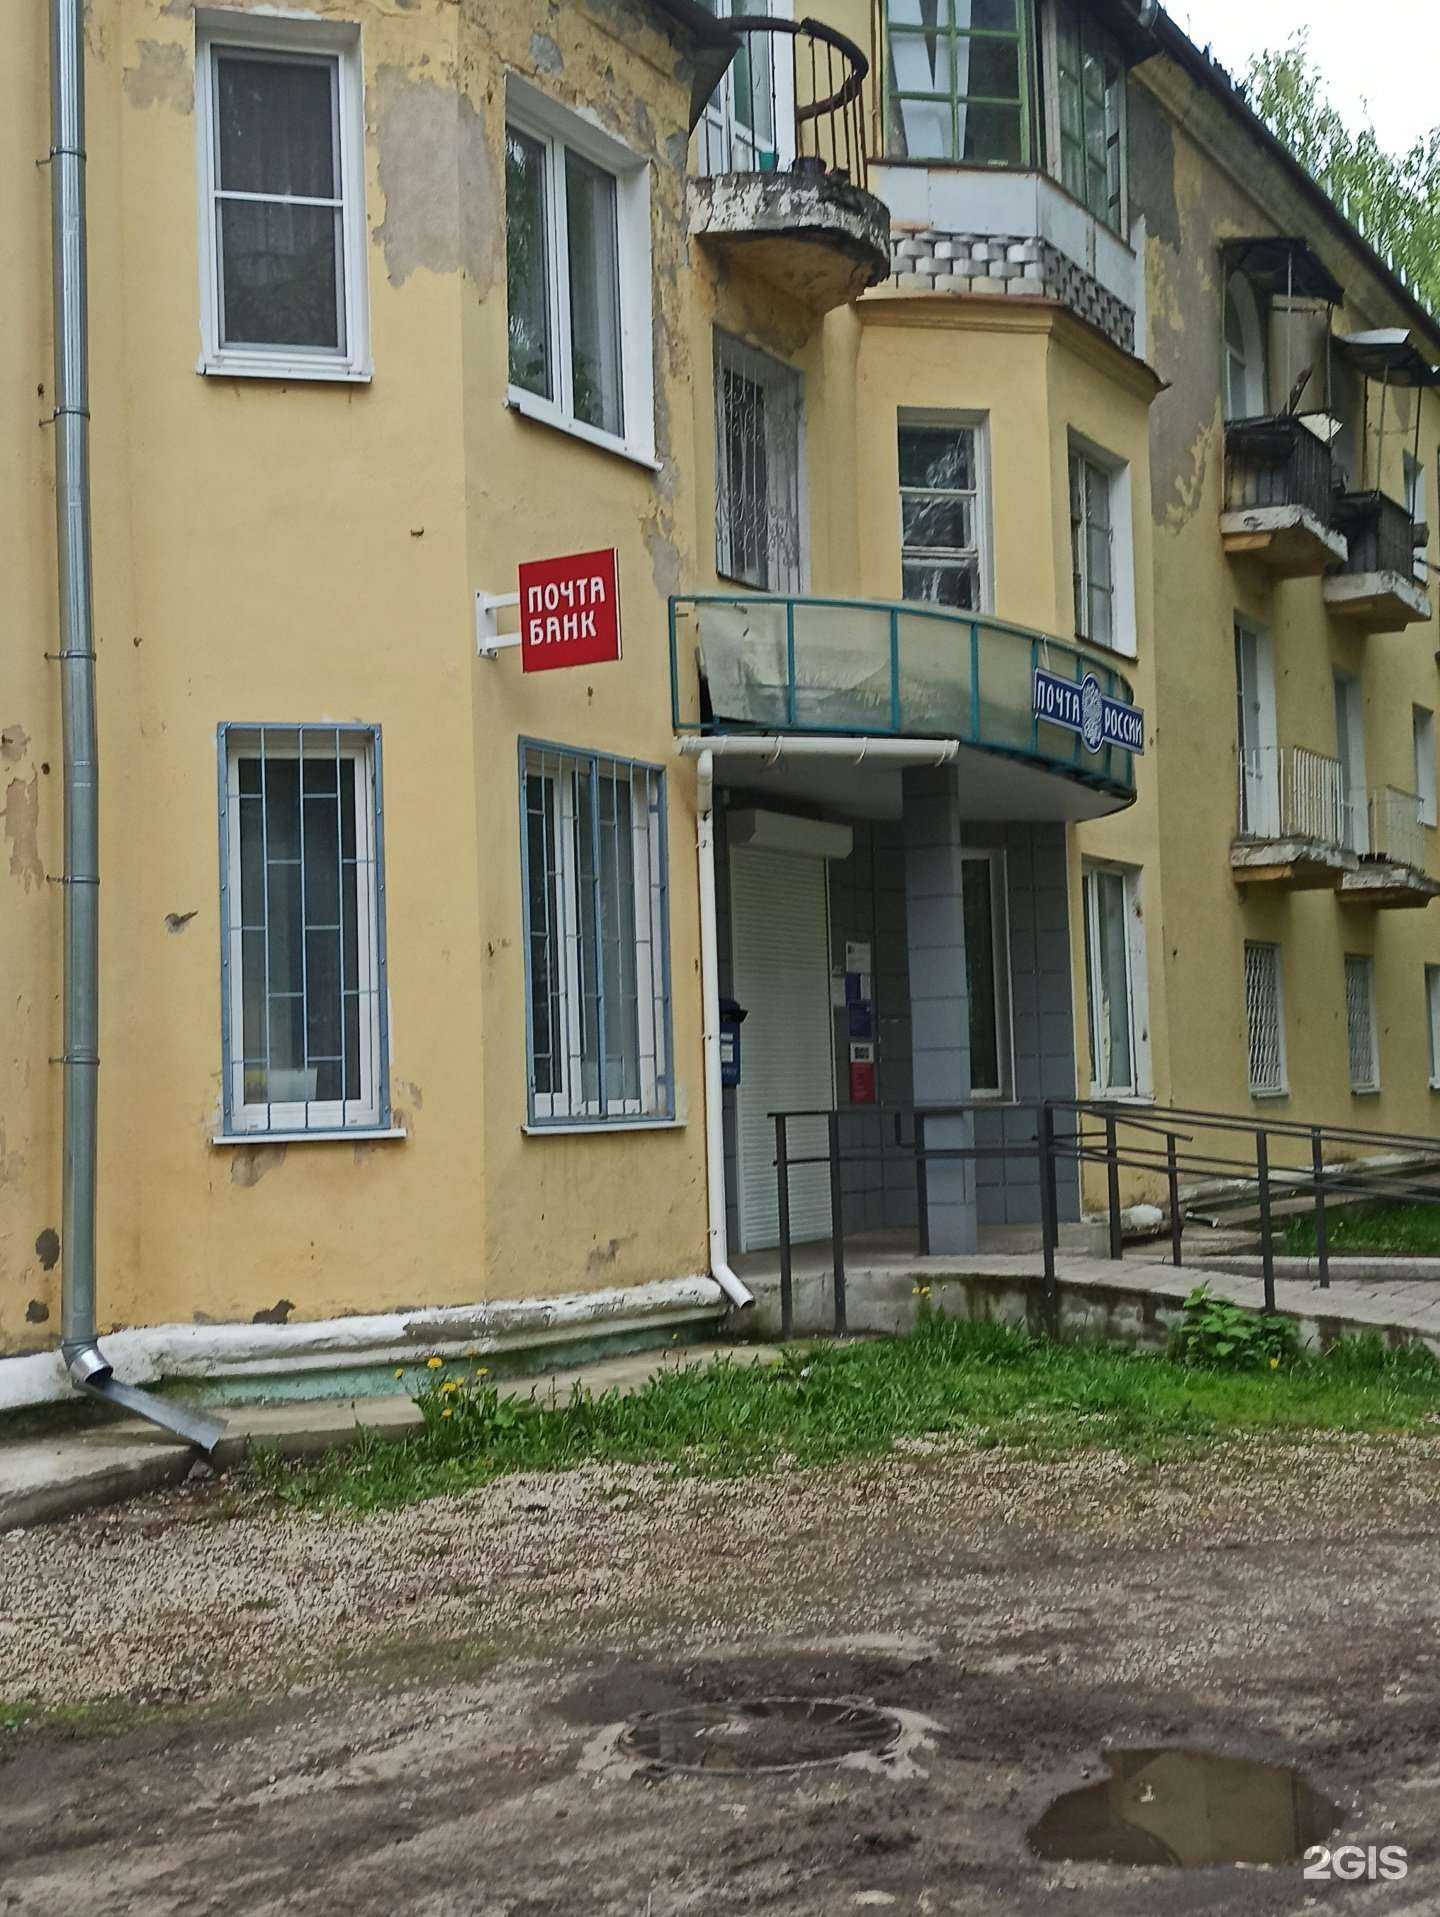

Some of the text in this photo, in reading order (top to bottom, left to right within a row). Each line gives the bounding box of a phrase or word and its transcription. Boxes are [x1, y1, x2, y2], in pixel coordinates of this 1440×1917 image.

[528, 576, 606, 613] ПОЧТА
[529, 610, 597, 646] БАНК
[1037, 680, 1142, 745] ПОЧТА РОССИИ
